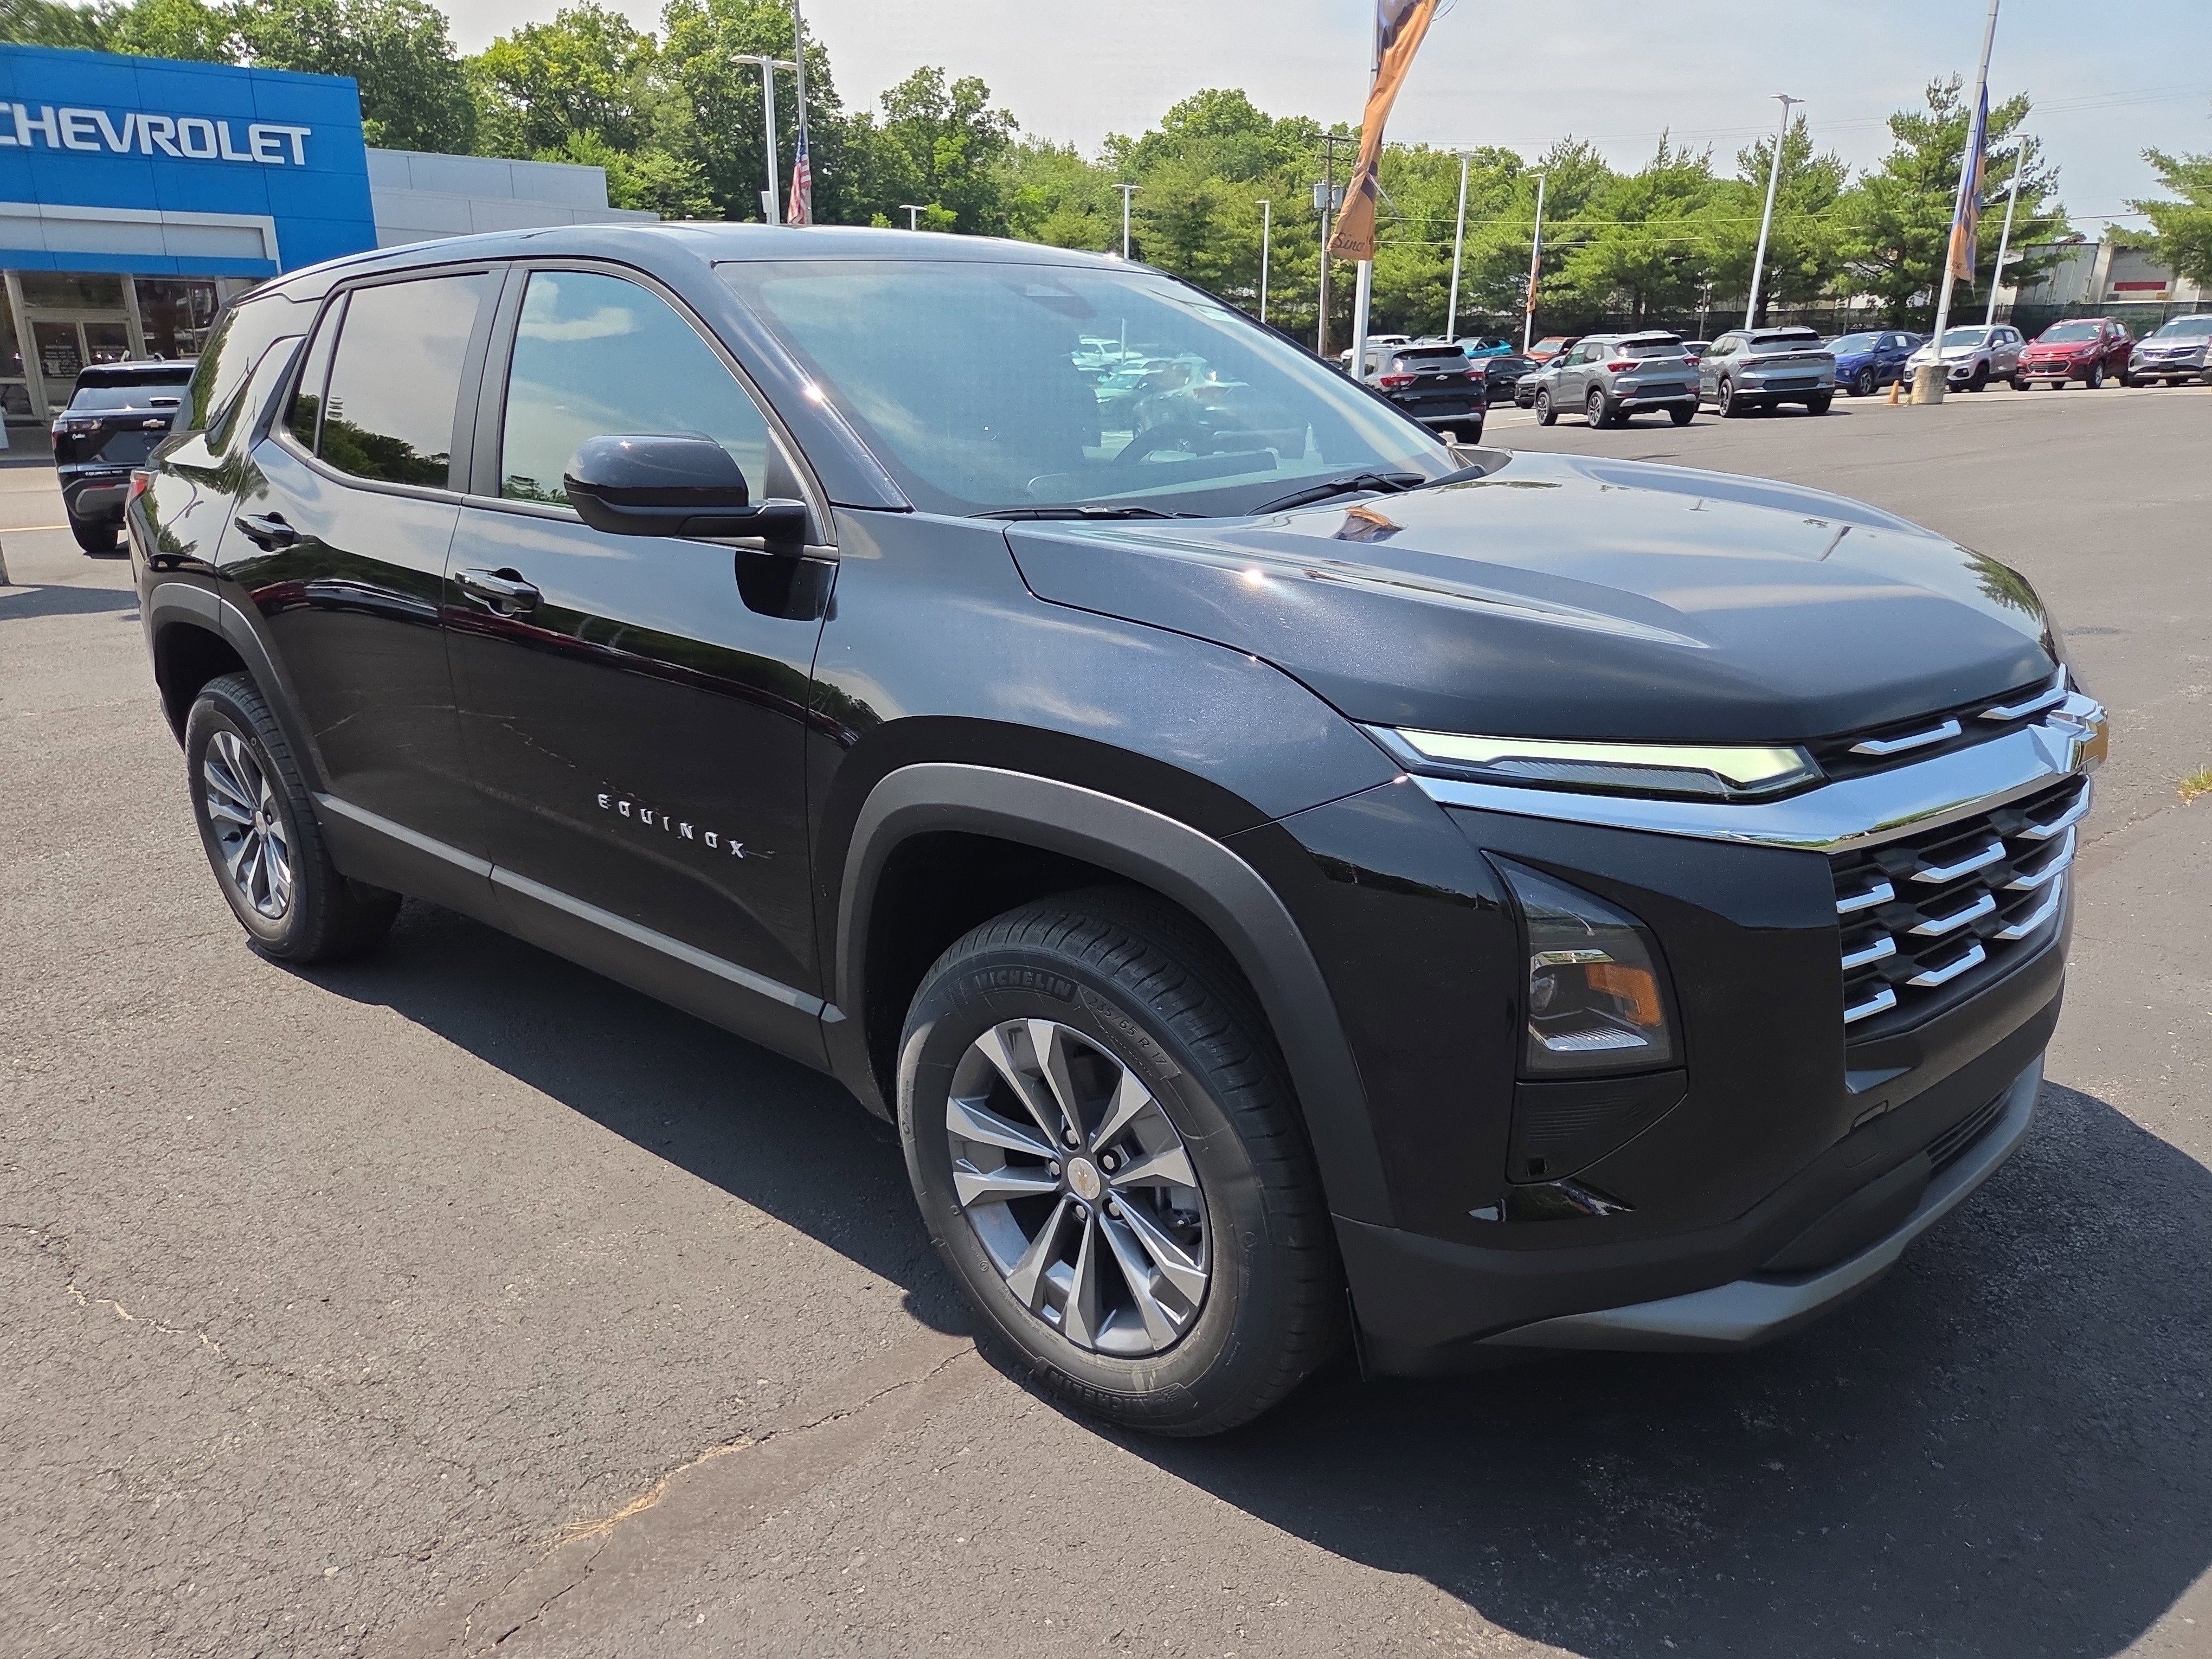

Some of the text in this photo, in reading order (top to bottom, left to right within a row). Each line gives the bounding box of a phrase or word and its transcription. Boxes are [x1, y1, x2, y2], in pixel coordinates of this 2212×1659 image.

[597, 793, 747, 859] EQUINOX
[973, 969, 1072, 997] MICHELIN
[1088, 996, 1138, 1037] 235/65
[1137, 1037, 1150, 1050] R
[1151, 1051, 1168, 1065] 17
